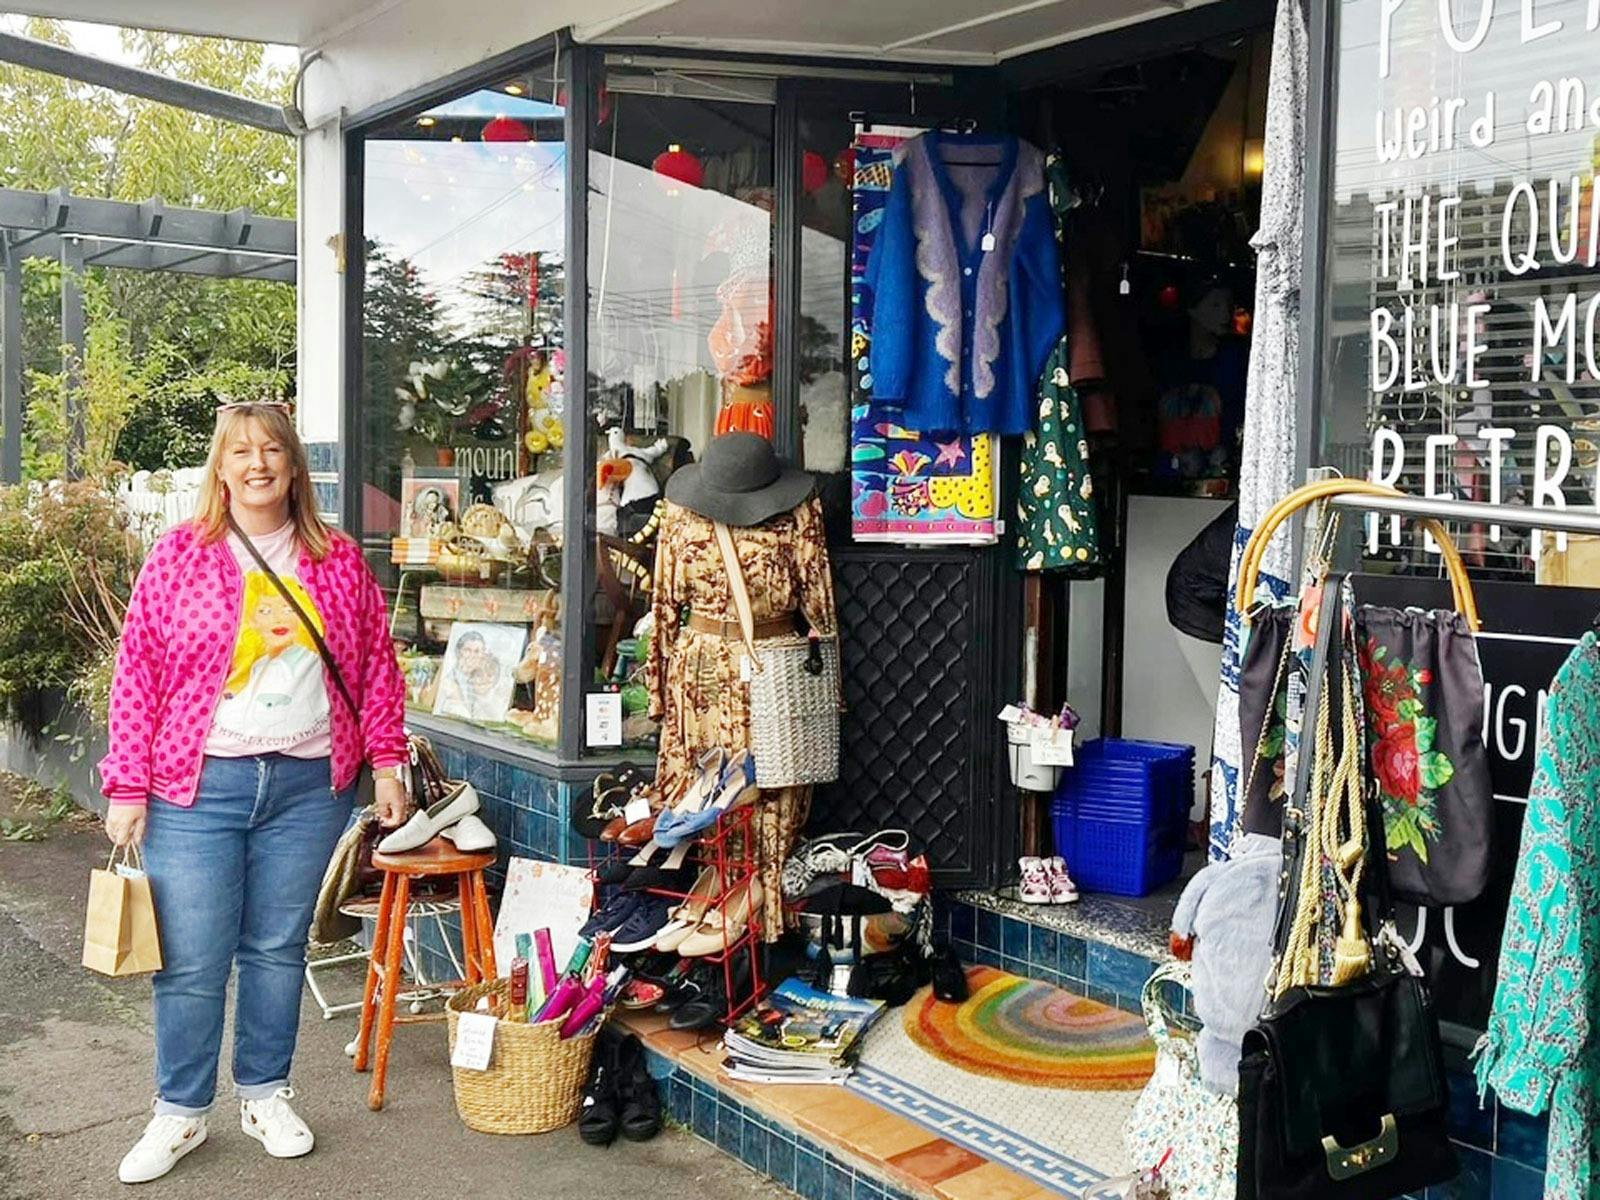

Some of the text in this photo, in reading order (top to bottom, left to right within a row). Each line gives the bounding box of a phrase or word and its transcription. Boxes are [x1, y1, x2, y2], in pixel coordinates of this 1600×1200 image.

[1376, 91, 1495, 162] weird
[1375, 194, 1461, 284] THE
[1370, 303, 1491, 392] BLUE
[454, 433, 520, 480] mount
[1369, 424, 1600, 561] RETR
